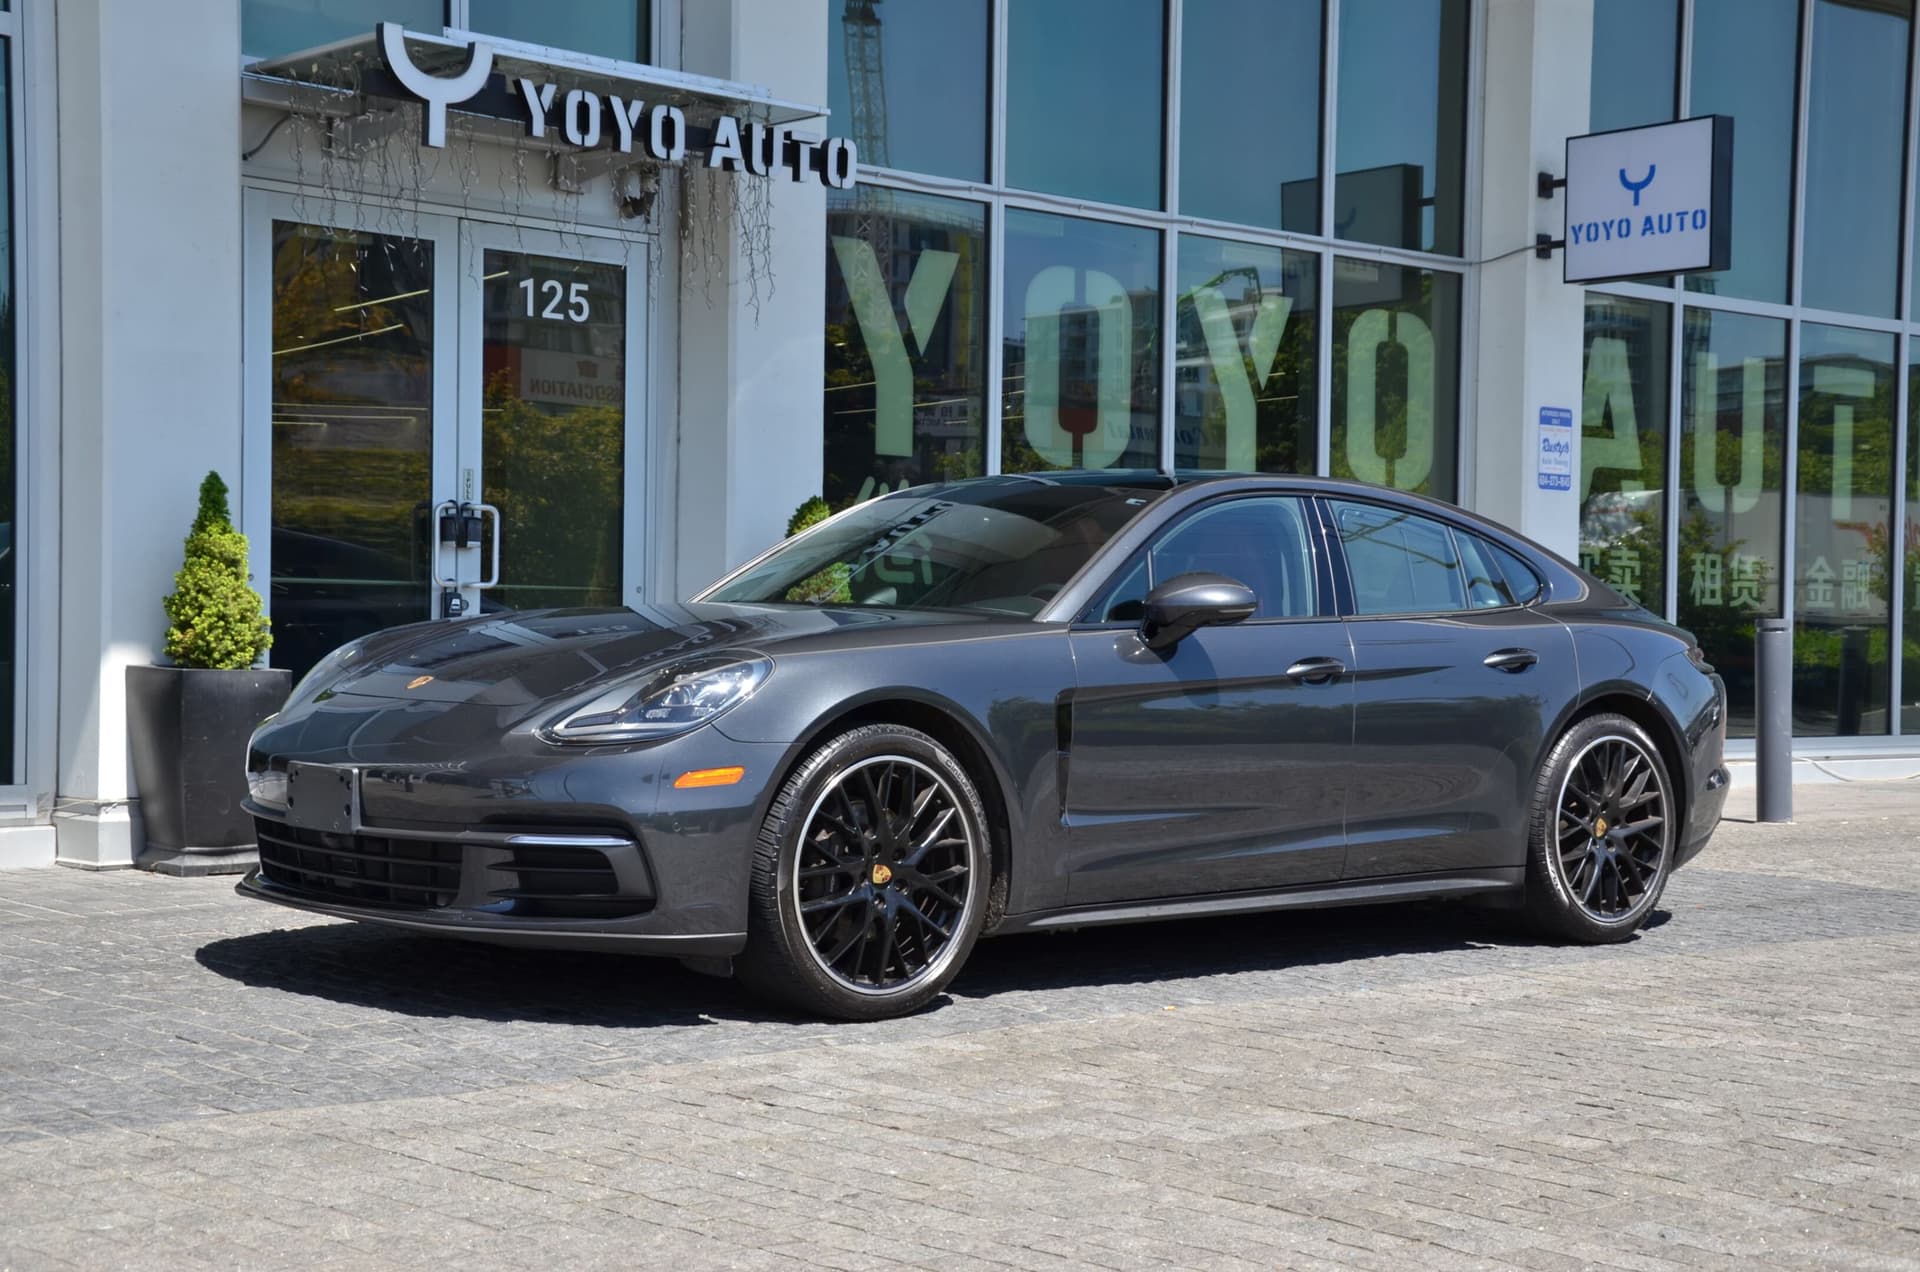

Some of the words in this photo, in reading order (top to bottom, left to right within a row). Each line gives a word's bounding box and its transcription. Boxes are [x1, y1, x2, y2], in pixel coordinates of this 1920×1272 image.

[516, 78, 685, 161] YOYO
[706, 115, 857, 189] AUTO
[1571, 217, 1631, 245] YOYO
[1641, 208, 1707, 237] AUTO
[519, 278, 590, 322] 125
[831, 235, 1434, 491] YOYO
[1580, 337, 1920, 521] AUT
[1691, 551, 1761, 609] 租赁
[1806, 555, 1871, 611] 金融
